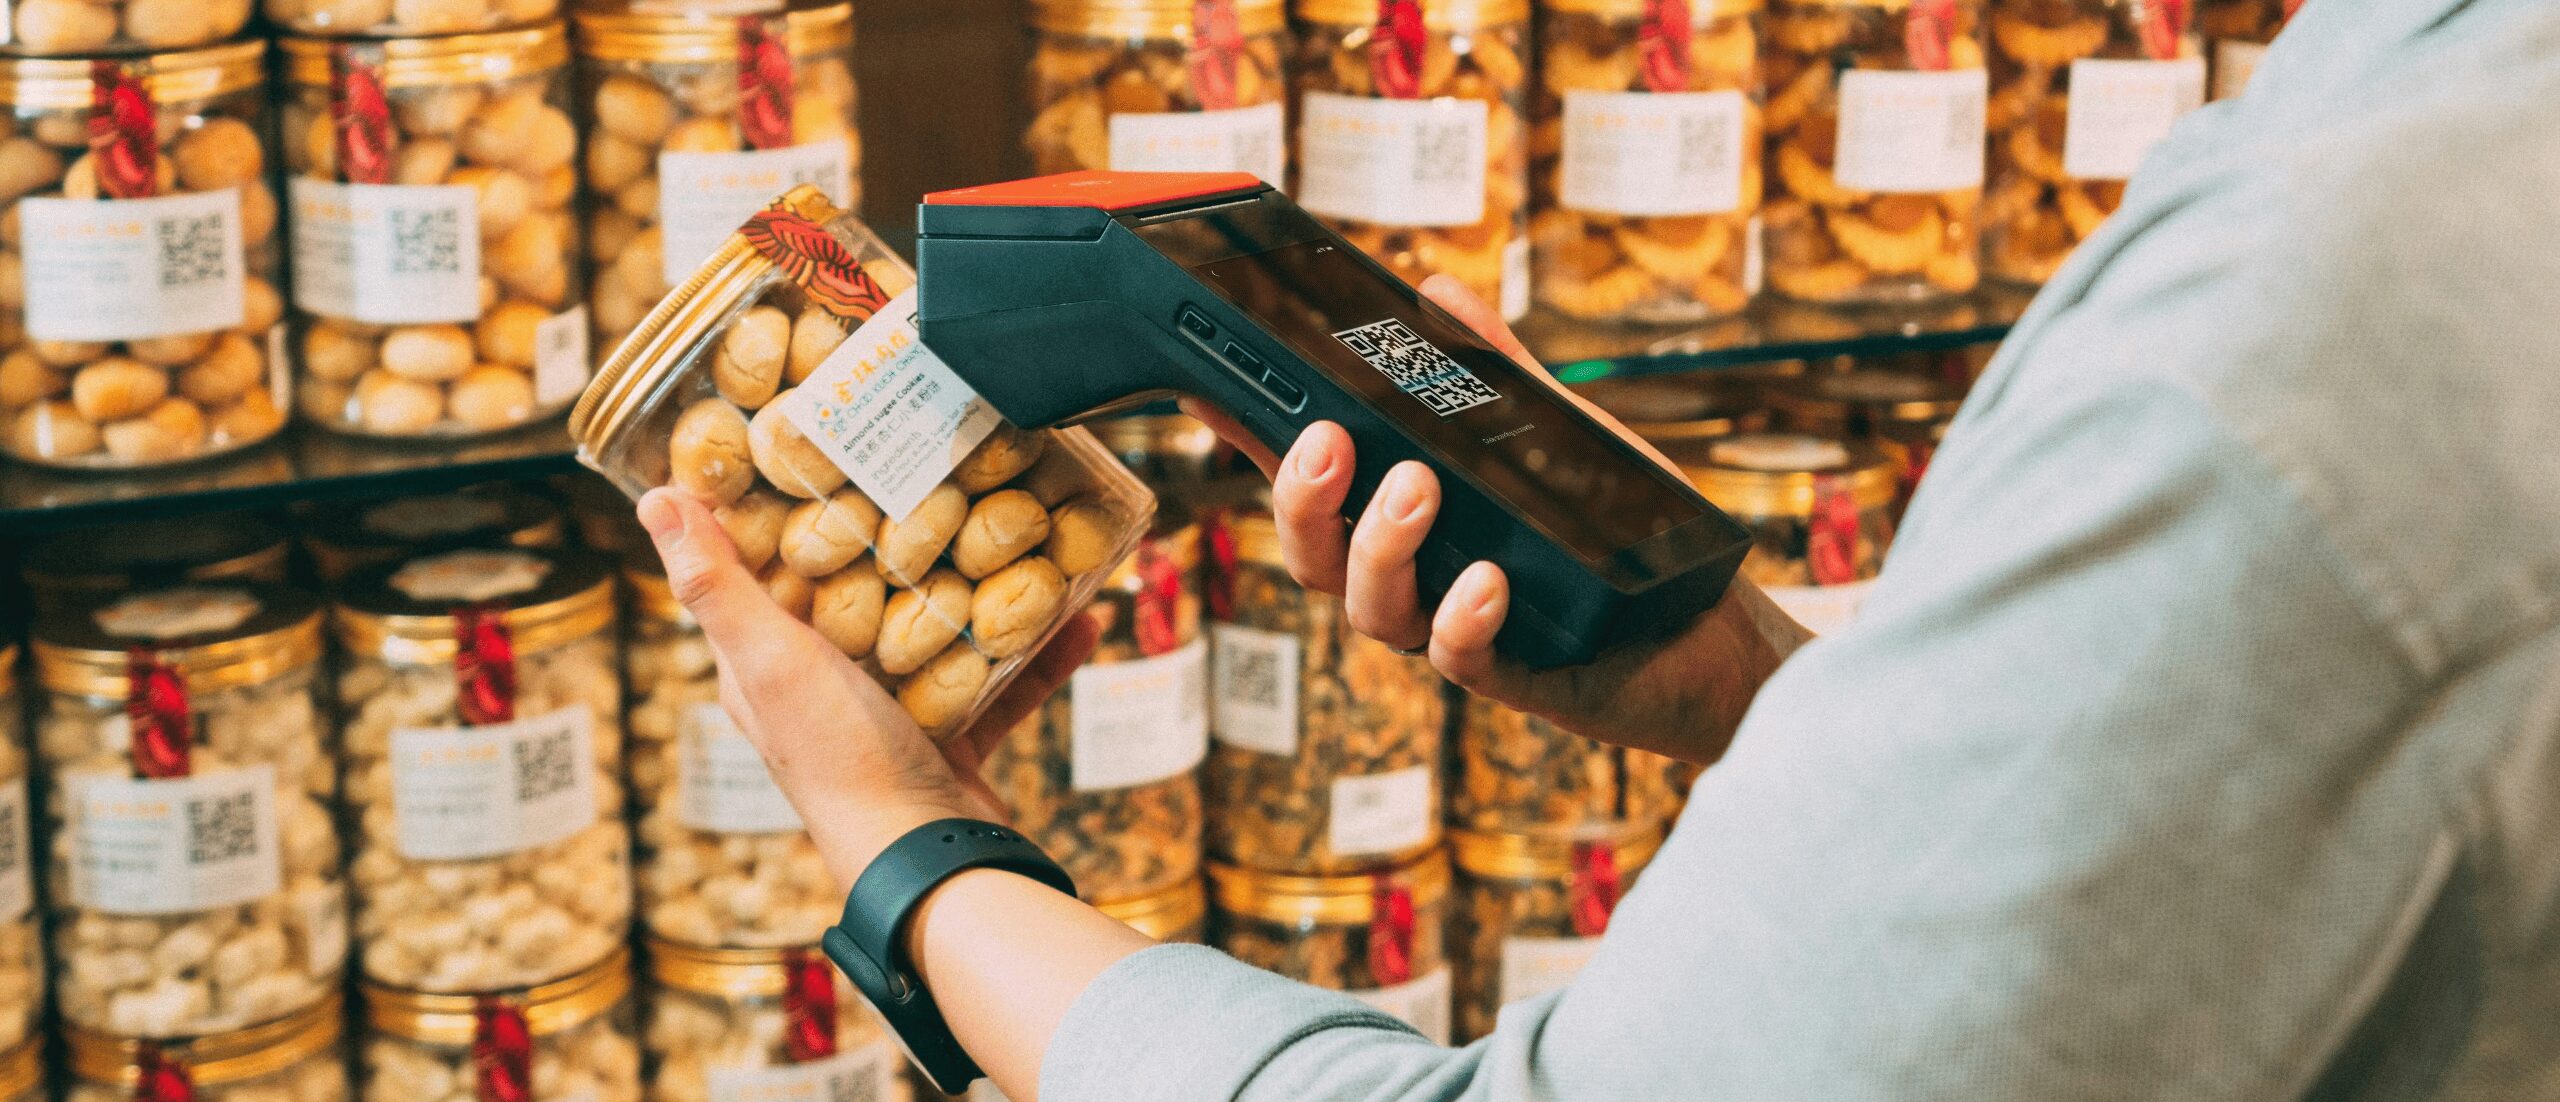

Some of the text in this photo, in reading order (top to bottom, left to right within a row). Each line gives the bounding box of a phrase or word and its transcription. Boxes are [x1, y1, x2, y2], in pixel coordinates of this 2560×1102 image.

[843, 372, 926, 452] Almond sugee Cookies
[871, 431, 922, 480] Ingredients
